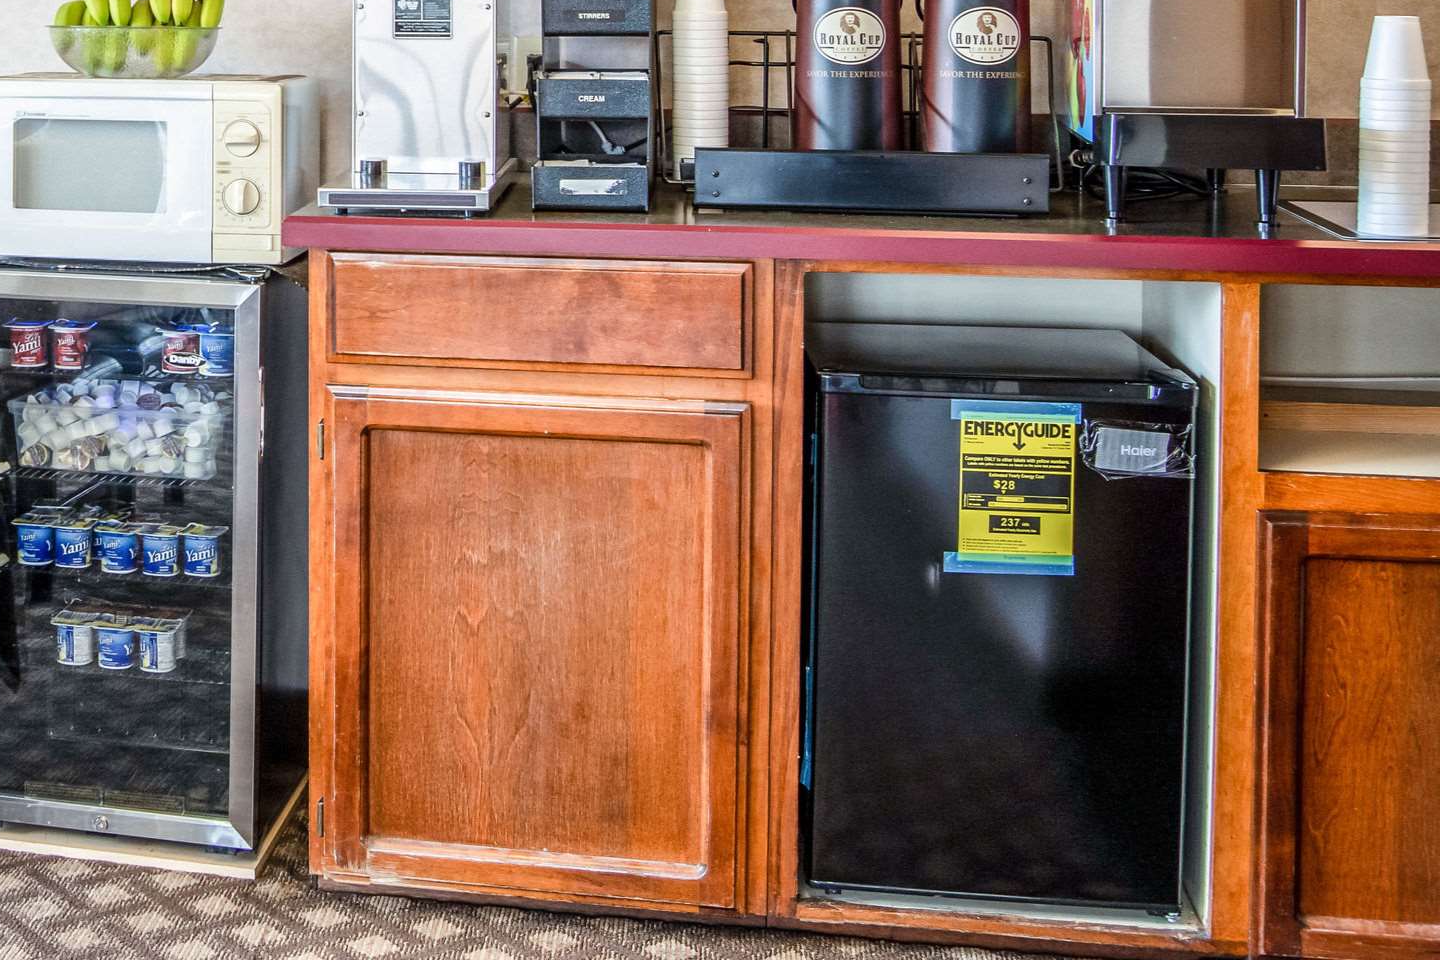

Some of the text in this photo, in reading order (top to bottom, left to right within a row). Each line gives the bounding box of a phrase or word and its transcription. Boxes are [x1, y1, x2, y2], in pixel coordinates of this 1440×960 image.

[820, 32, 881, 46] ROYAL CUP
[955, 32, 1017, 46] ROYAL CUP
[830, 70, 847, 78] THE
[966, 71, 984, 79] THE
[578, 95, 606, 103] CREAM
[169, 354, 201, 366] Danby
[964, 420, 1071, 439] ENERGYGUIDE
[1120, 444, 1157, 457] Haier
[1000, 517, 1021, 527] 237
[61, 540, 89, 556] Yami
[147, 546, 177, 563] Yami
[186, 545, 216, 562] Yami
